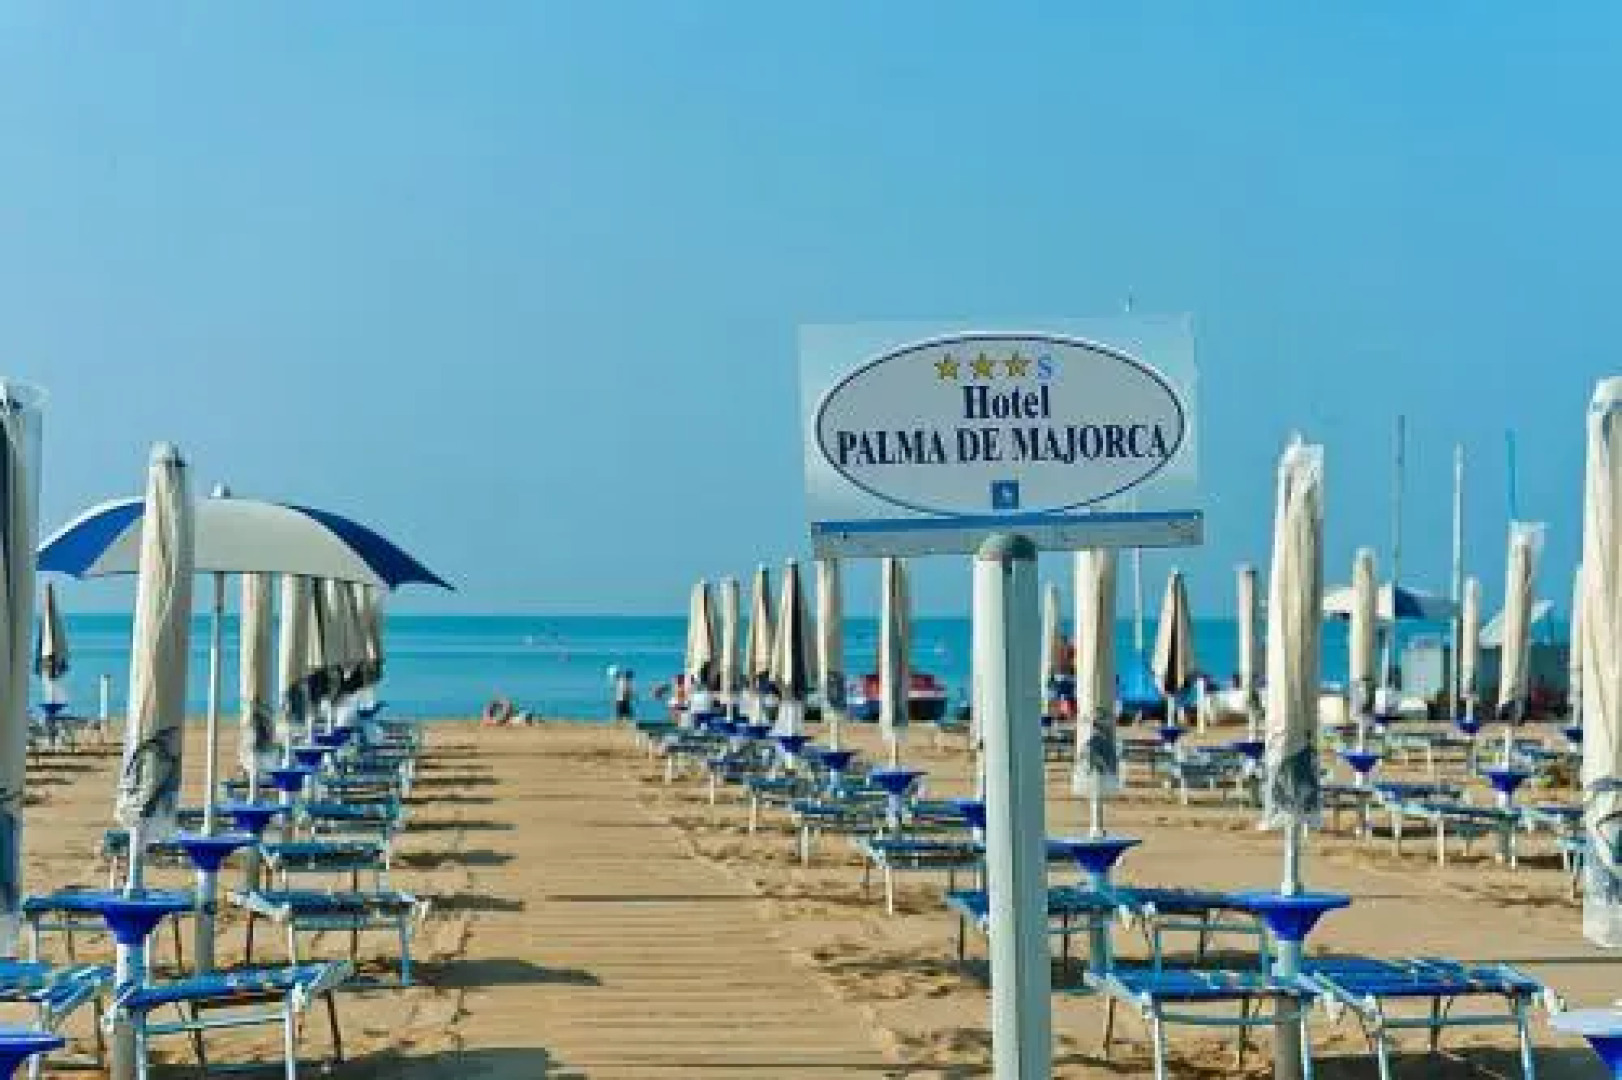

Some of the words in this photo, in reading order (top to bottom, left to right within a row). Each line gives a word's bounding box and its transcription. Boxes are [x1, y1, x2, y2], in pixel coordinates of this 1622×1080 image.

[1037, 355, 1054, 379] S
[962, 385, 1050, 419] Hotel
[837, 430, 947, 464] PALMA
[956, 427, 1001, 461] DE
[1011, 424, 1169, 464] MAJORCA
